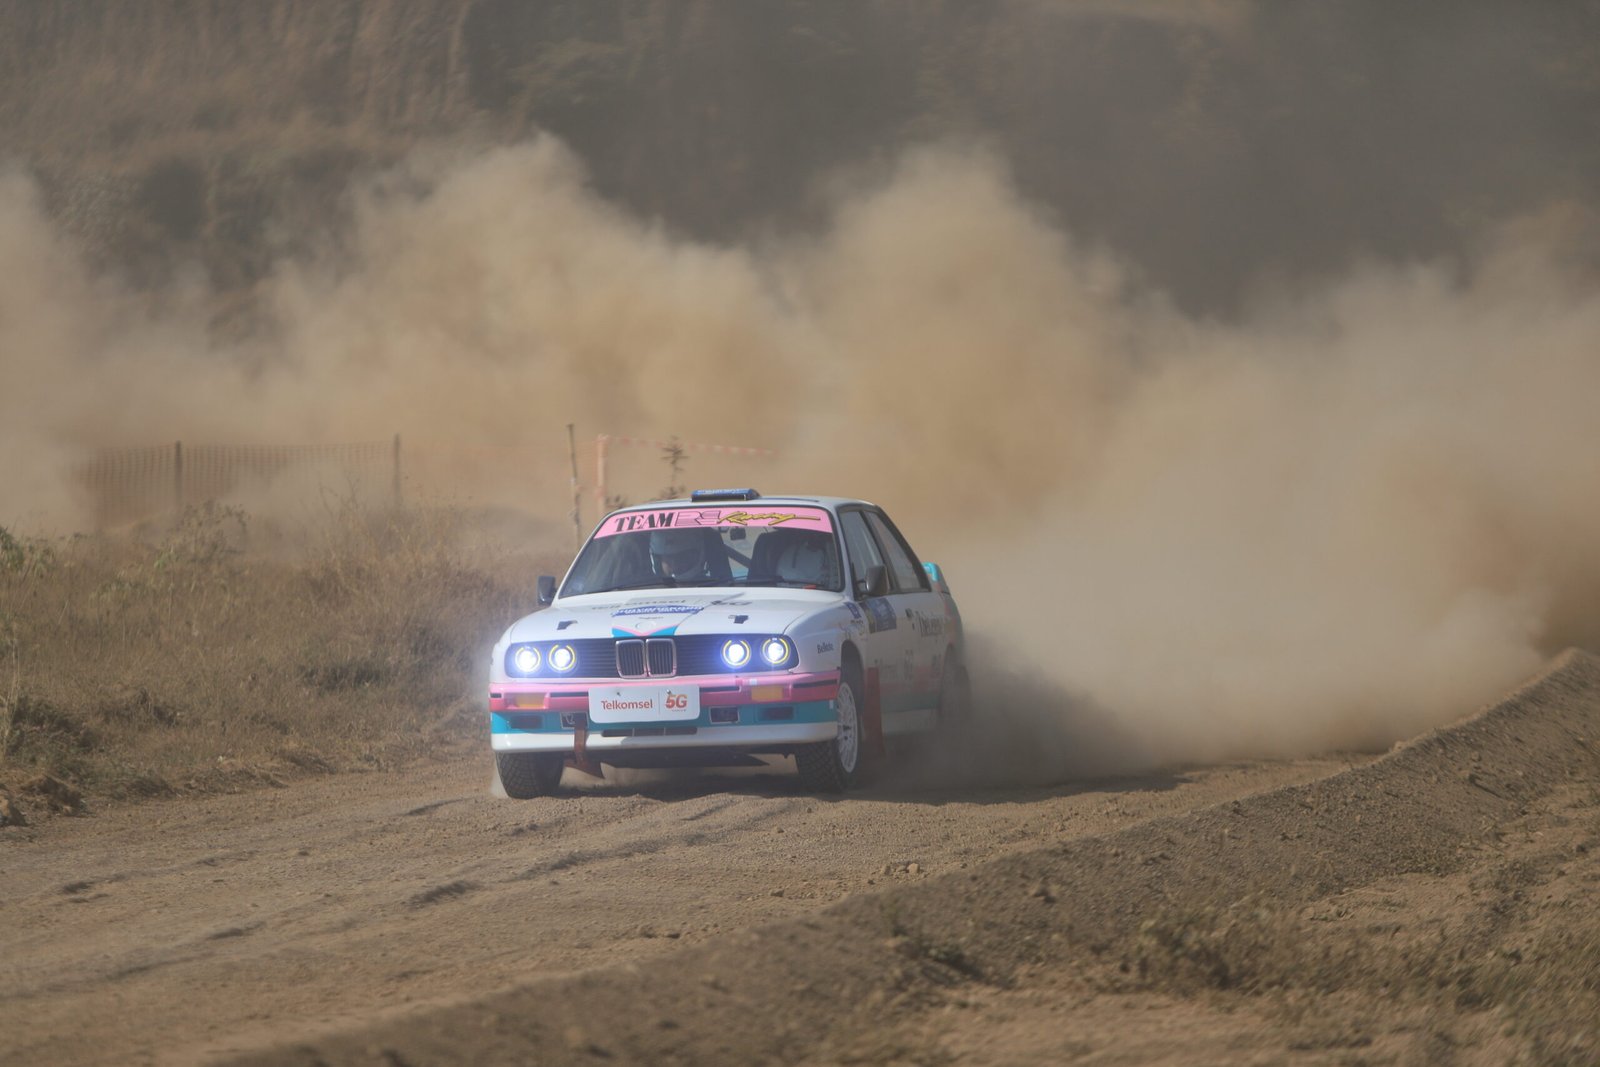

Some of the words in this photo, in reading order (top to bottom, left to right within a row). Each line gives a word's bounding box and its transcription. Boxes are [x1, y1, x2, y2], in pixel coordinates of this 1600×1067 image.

[614, 512, 675, 532] TEAM
[718, 510, 821, 526] Racing
[601, 699, 653, 710] Telkomsel
[665, 693, 688, 709] 5G
